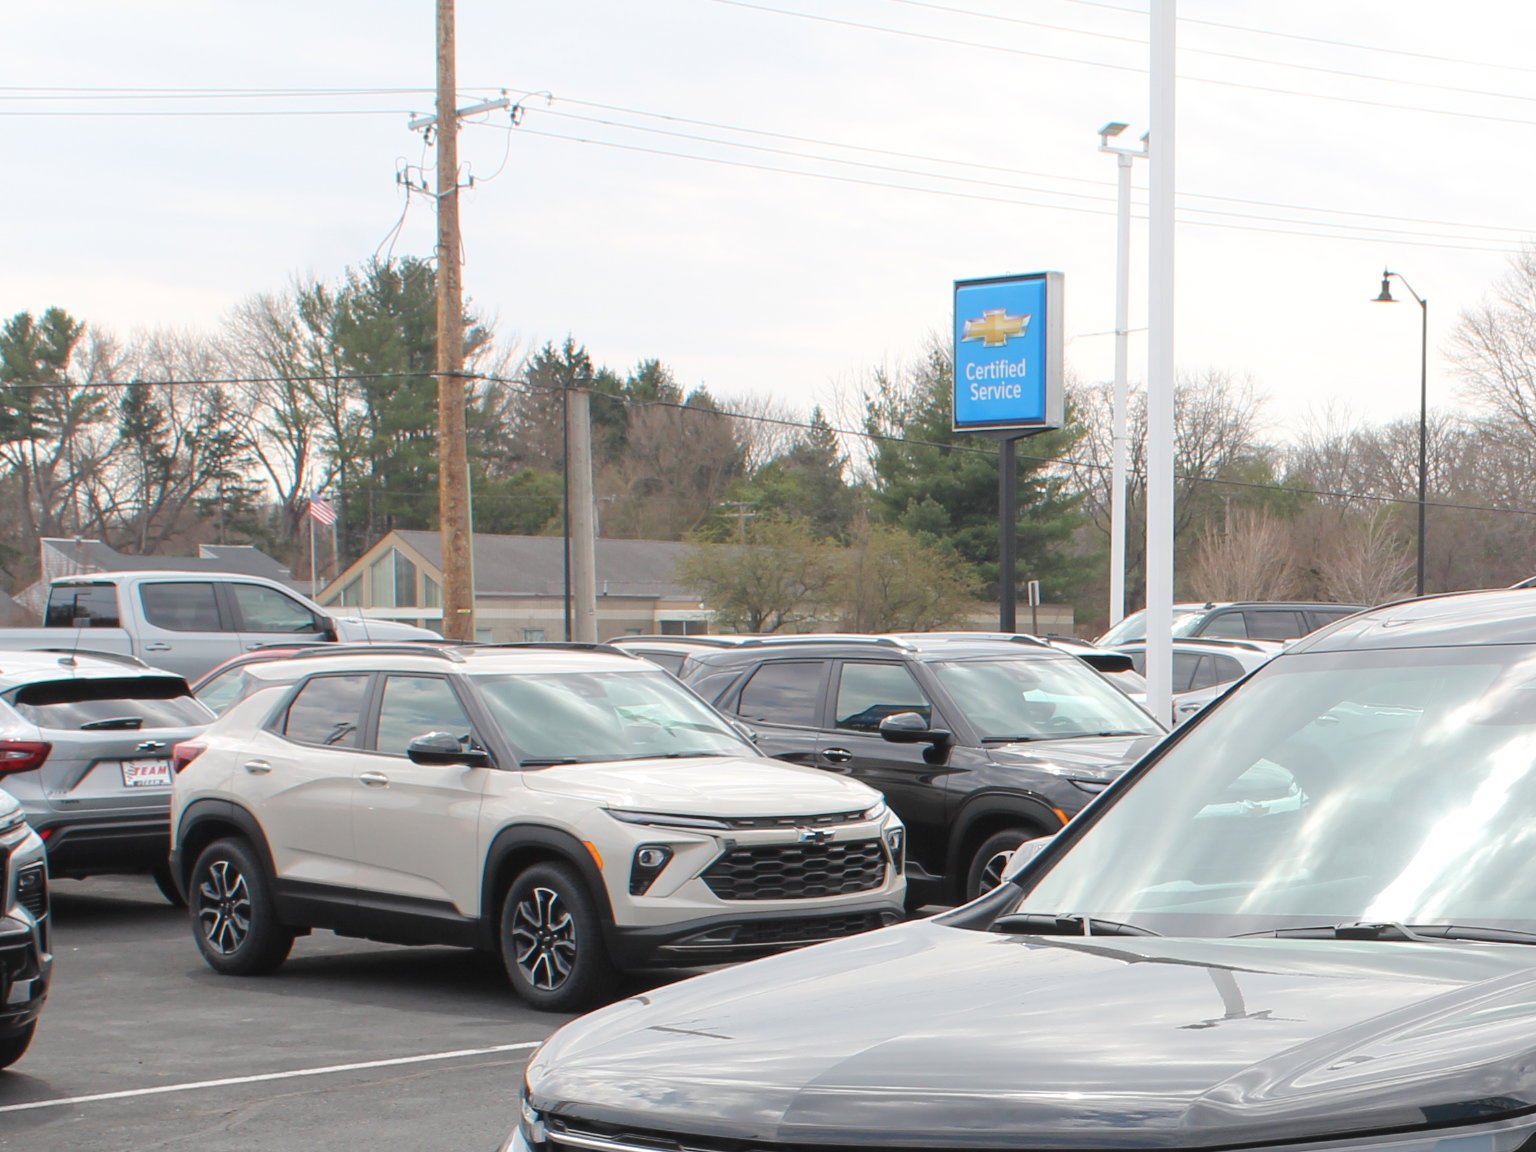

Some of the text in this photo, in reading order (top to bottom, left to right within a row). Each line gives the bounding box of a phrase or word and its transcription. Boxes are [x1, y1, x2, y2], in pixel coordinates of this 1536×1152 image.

[966, 358, 1026, 381] Certified
[970, 382, 1022, 401] Service
[134, 766, 166, 776] TEAM
